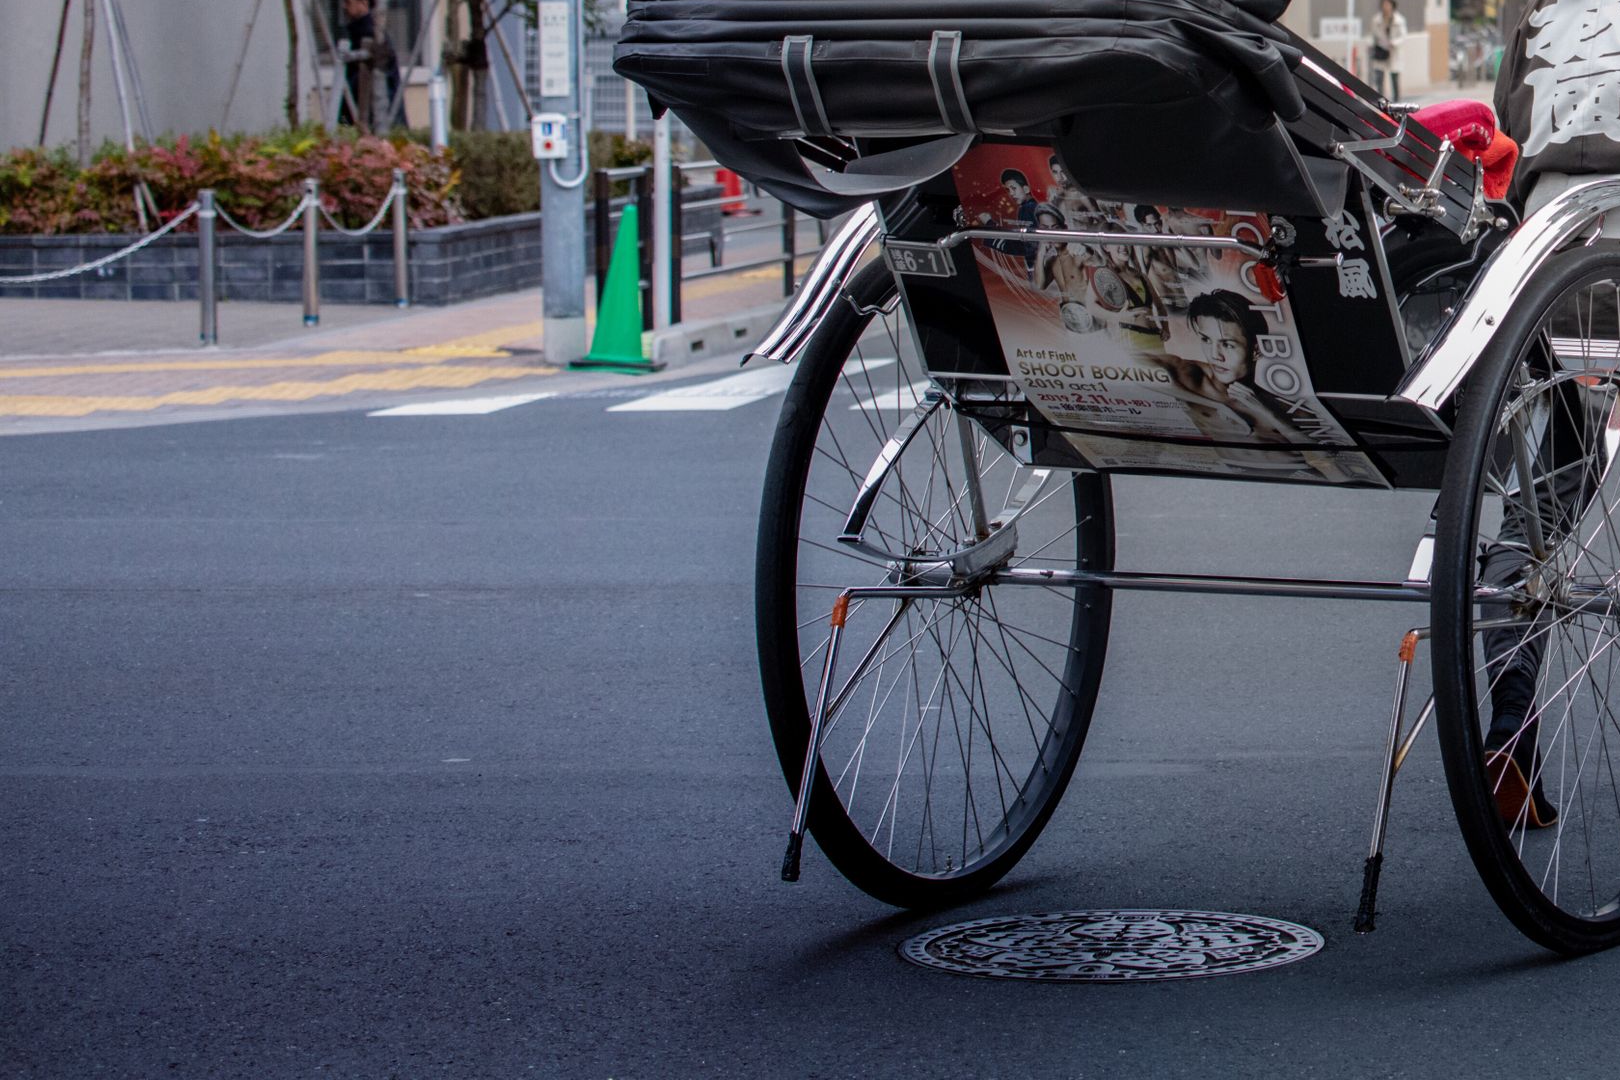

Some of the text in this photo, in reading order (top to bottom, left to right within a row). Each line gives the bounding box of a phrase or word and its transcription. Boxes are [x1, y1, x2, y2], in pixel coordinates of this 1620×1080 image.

[1016, 348, 1077, 363] Art of Fight
[1019, 361, 1171, 384] SHOOT BOXING
[1025, 378, 1064, 391] 2019
